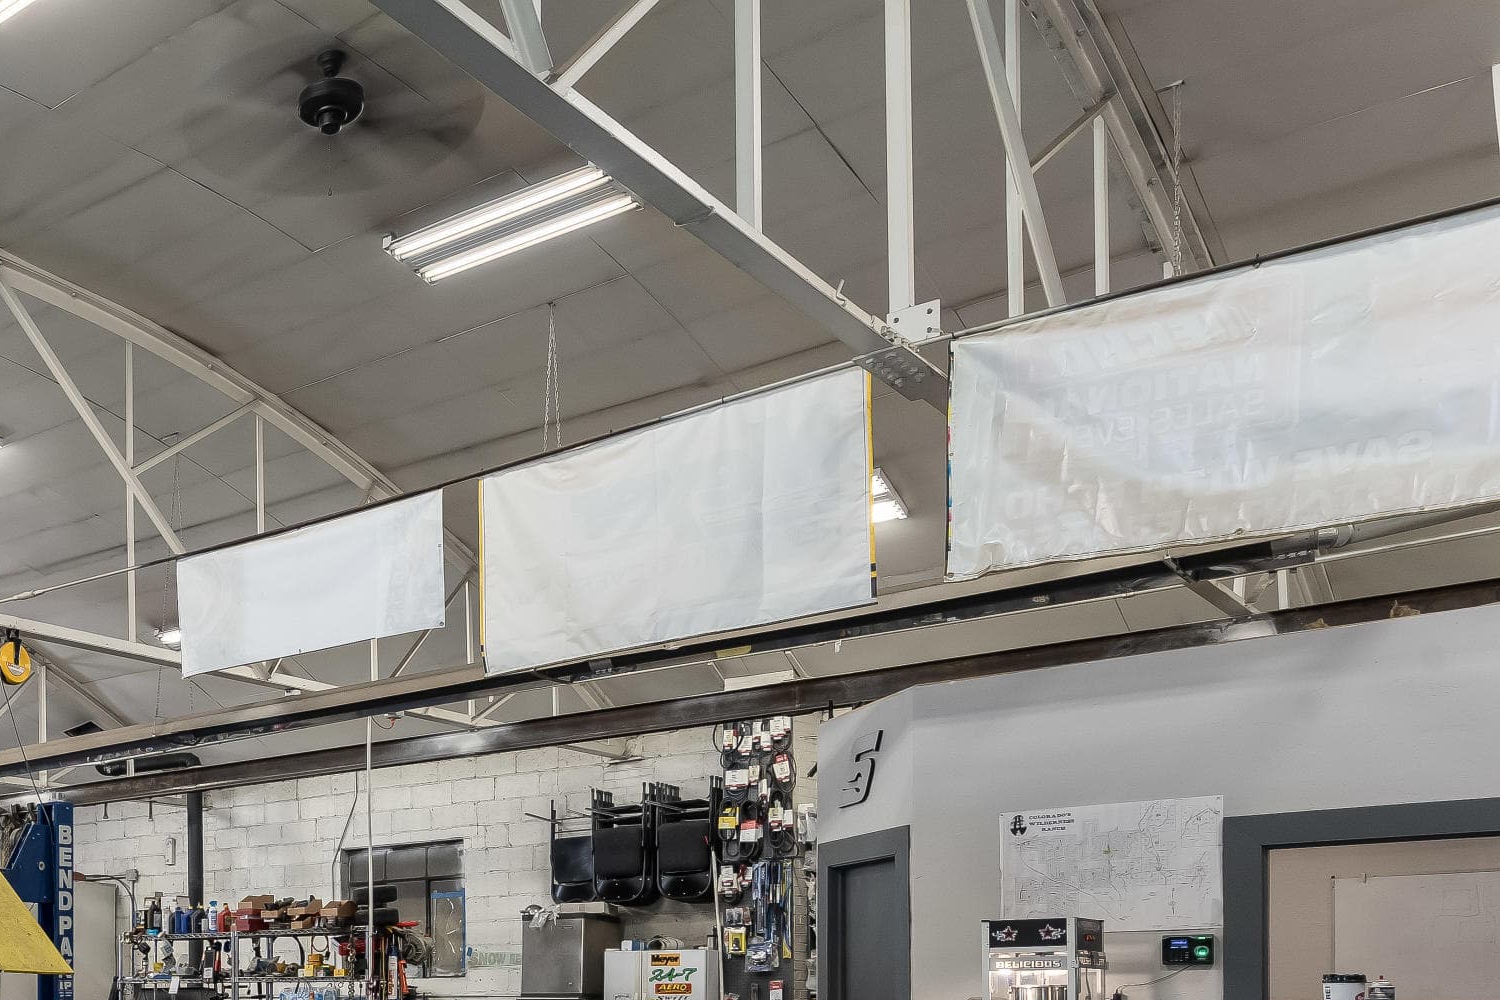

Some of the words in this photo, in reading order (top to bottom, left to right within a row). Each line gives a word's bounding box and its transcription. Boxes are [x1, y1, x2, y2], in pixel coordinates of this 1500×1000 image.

[651, 954, 679, 966] Meyer
[995, 960, 1060, 969] DELICIOUS
[649, 967, 698, 982] 24-7
